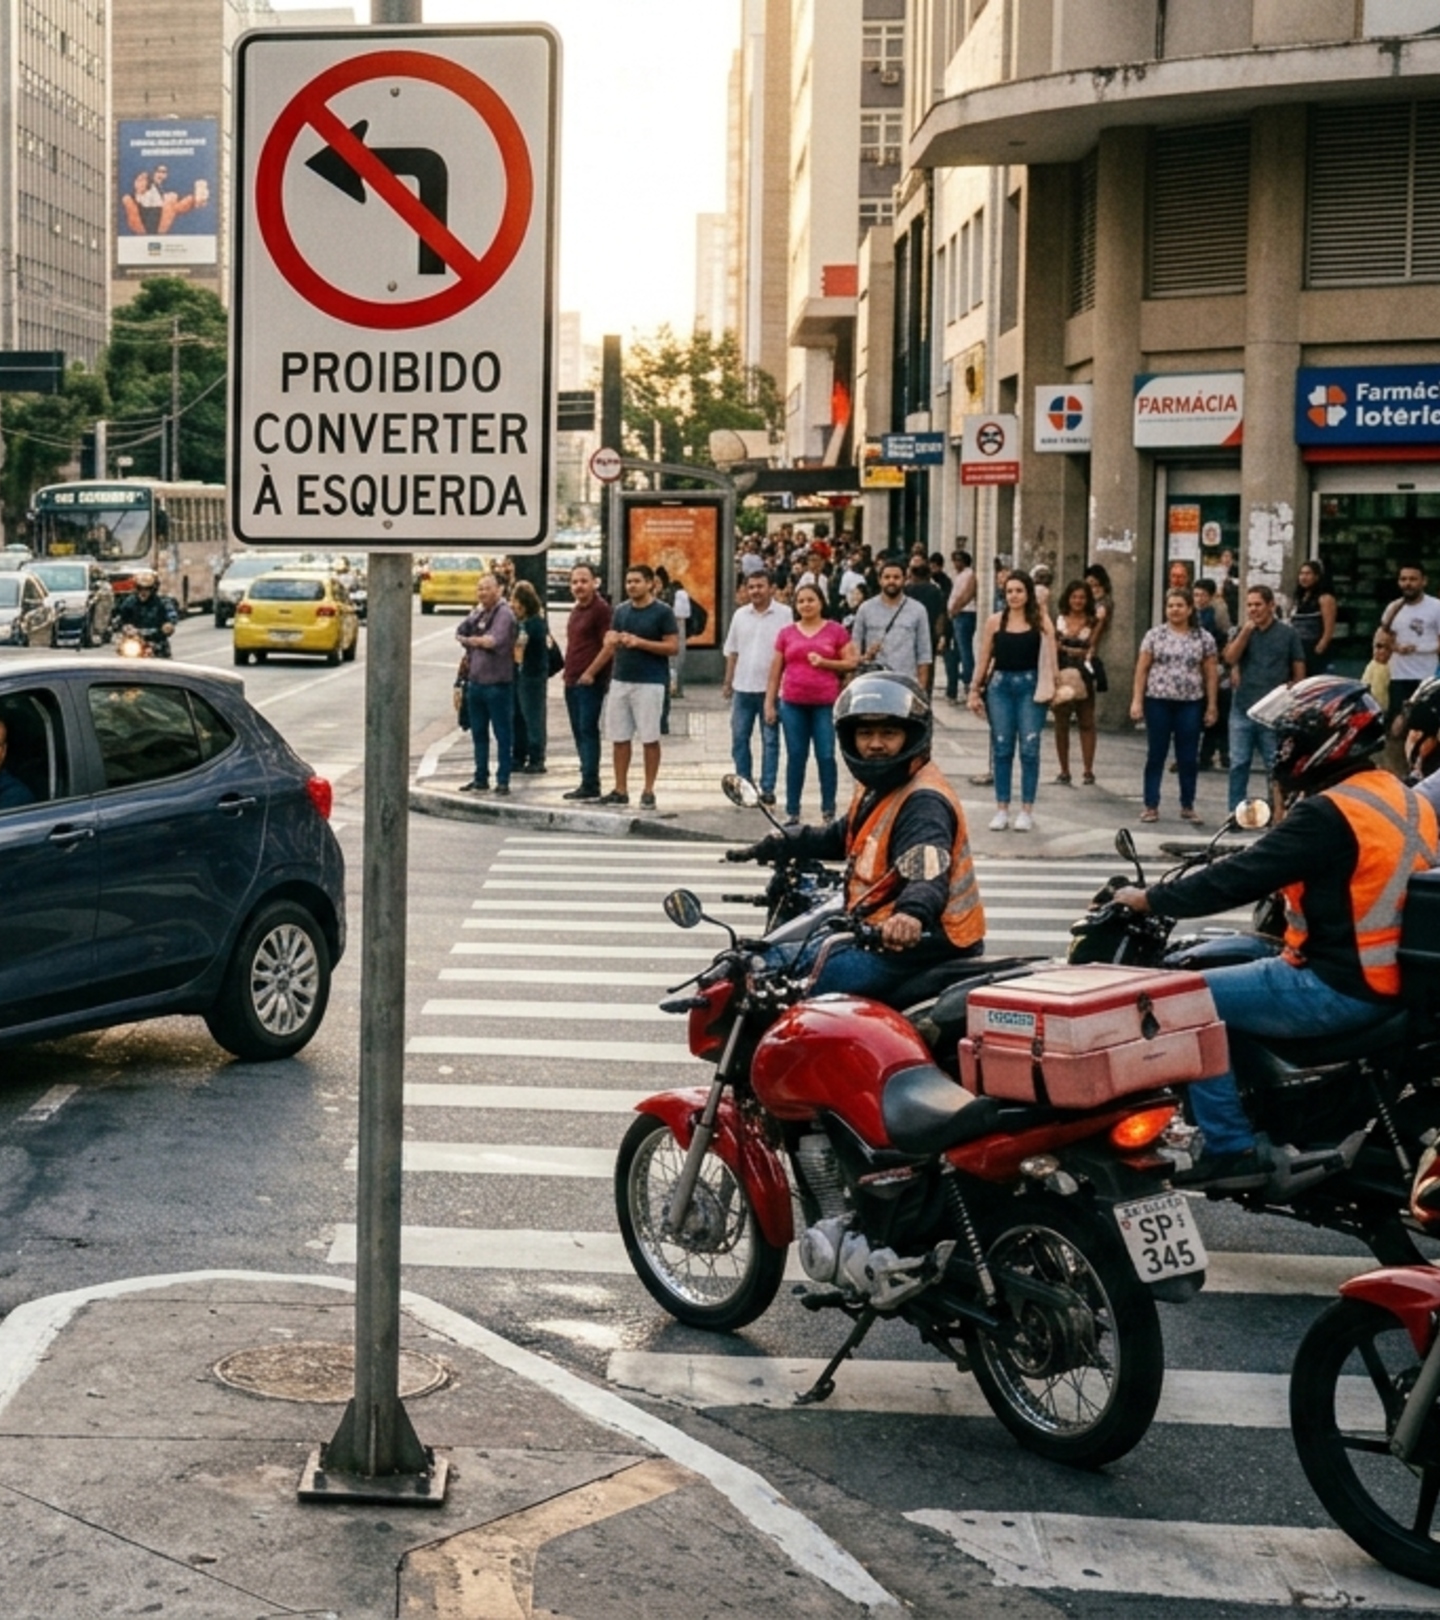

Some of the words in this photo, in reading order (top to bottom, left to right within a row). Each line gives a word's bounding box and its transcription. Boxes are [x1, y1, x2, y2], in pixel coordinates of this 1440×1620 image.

[281, 351, 501, 393] PROIBIDO
[1356, 381, 1440, 401] Farmác
[253, 412, 528, 454] CONVERTER
[253, 464, 282, 516] À
[297, 474, 527, 517] ESQUERDA
[1139, 1214, 1173, 1244] SP
[1142, 1239, 1195, 1274] 345
